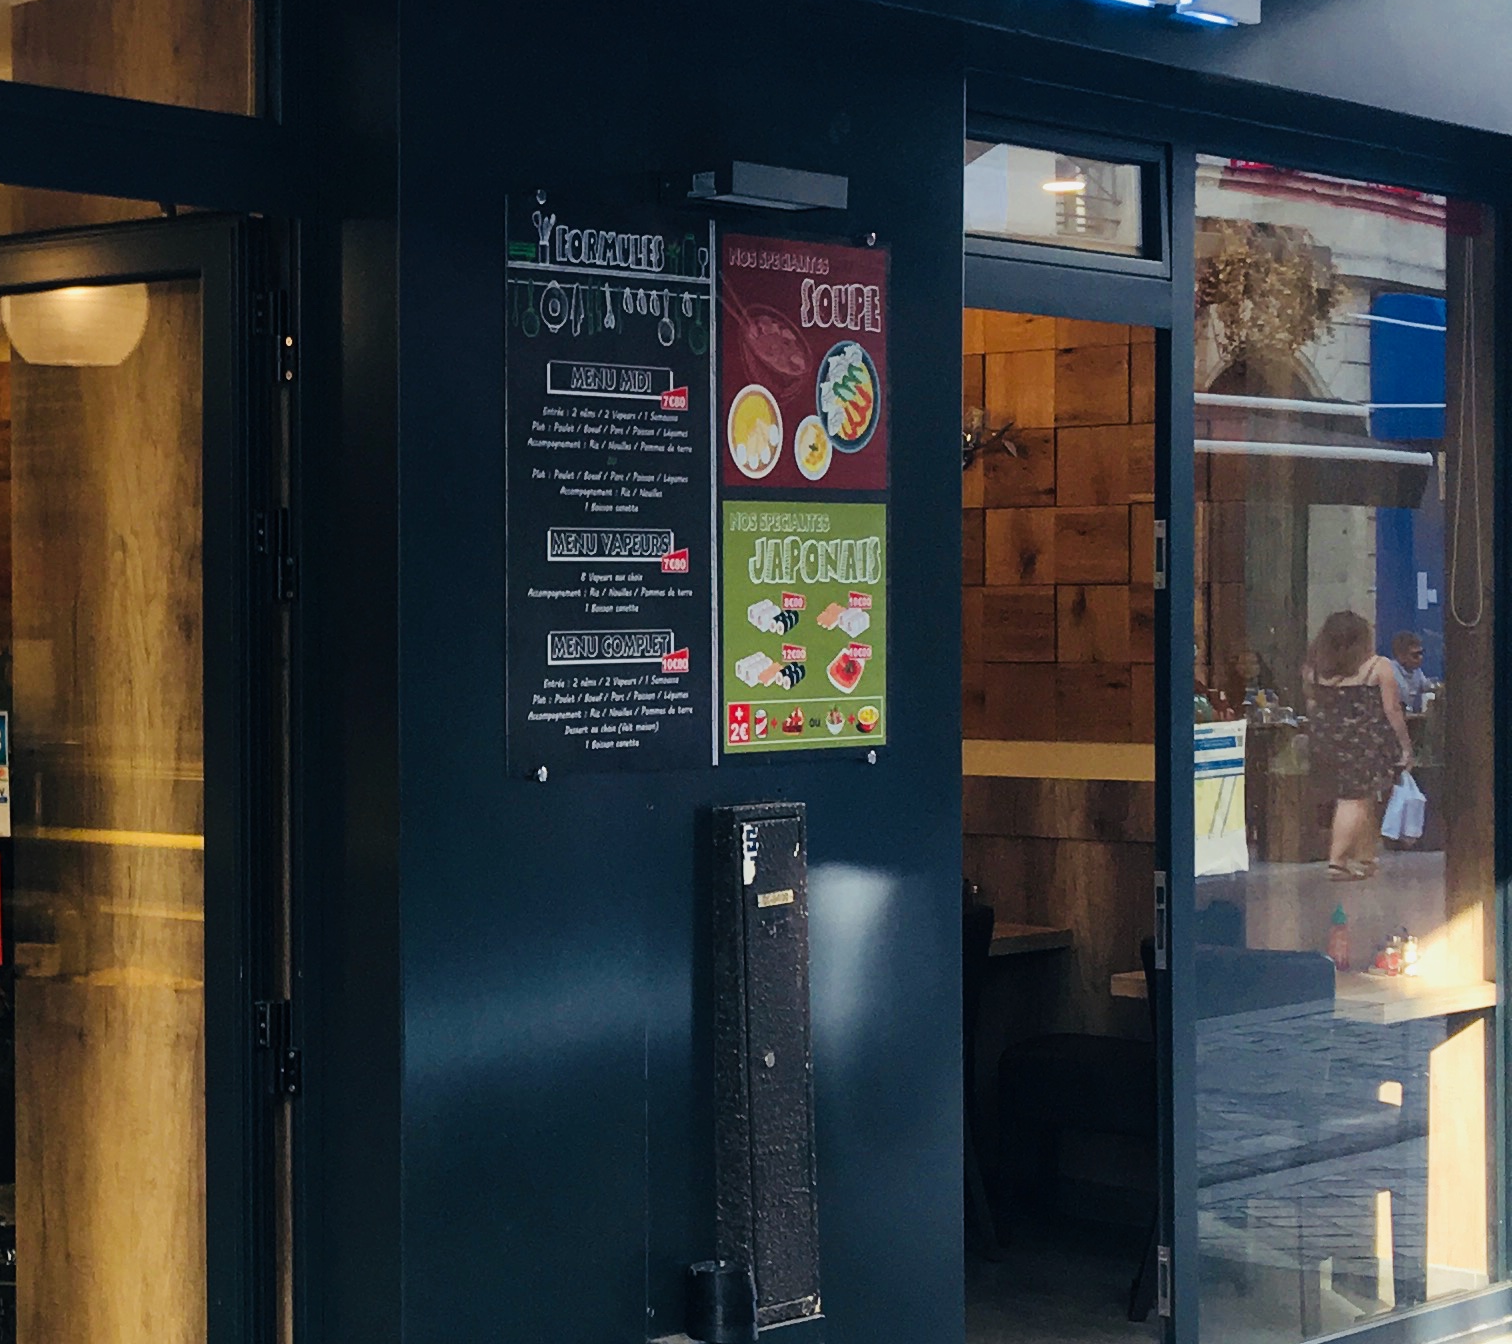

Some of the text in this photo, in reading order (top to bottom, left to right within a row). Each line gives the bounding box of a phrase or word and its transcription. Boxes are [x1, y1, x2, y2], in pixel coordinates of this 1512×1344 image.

[556, 225, 664, 272] FORMULES
[730, 248, 757, 268] NOS
[801, 278, 881, 332] SOUPE
[571, 367, 652, 393] MENU MIDI
[730, 512, 830, 532] NOS SPECIALITES
[552, 533, 671, 555] MENU VAPEURS
[749, 536, 882, 584] JAPONAIS
[553, 634, 669, 658] MENU COMPLET
[730, 723, 749, 741] 2€
